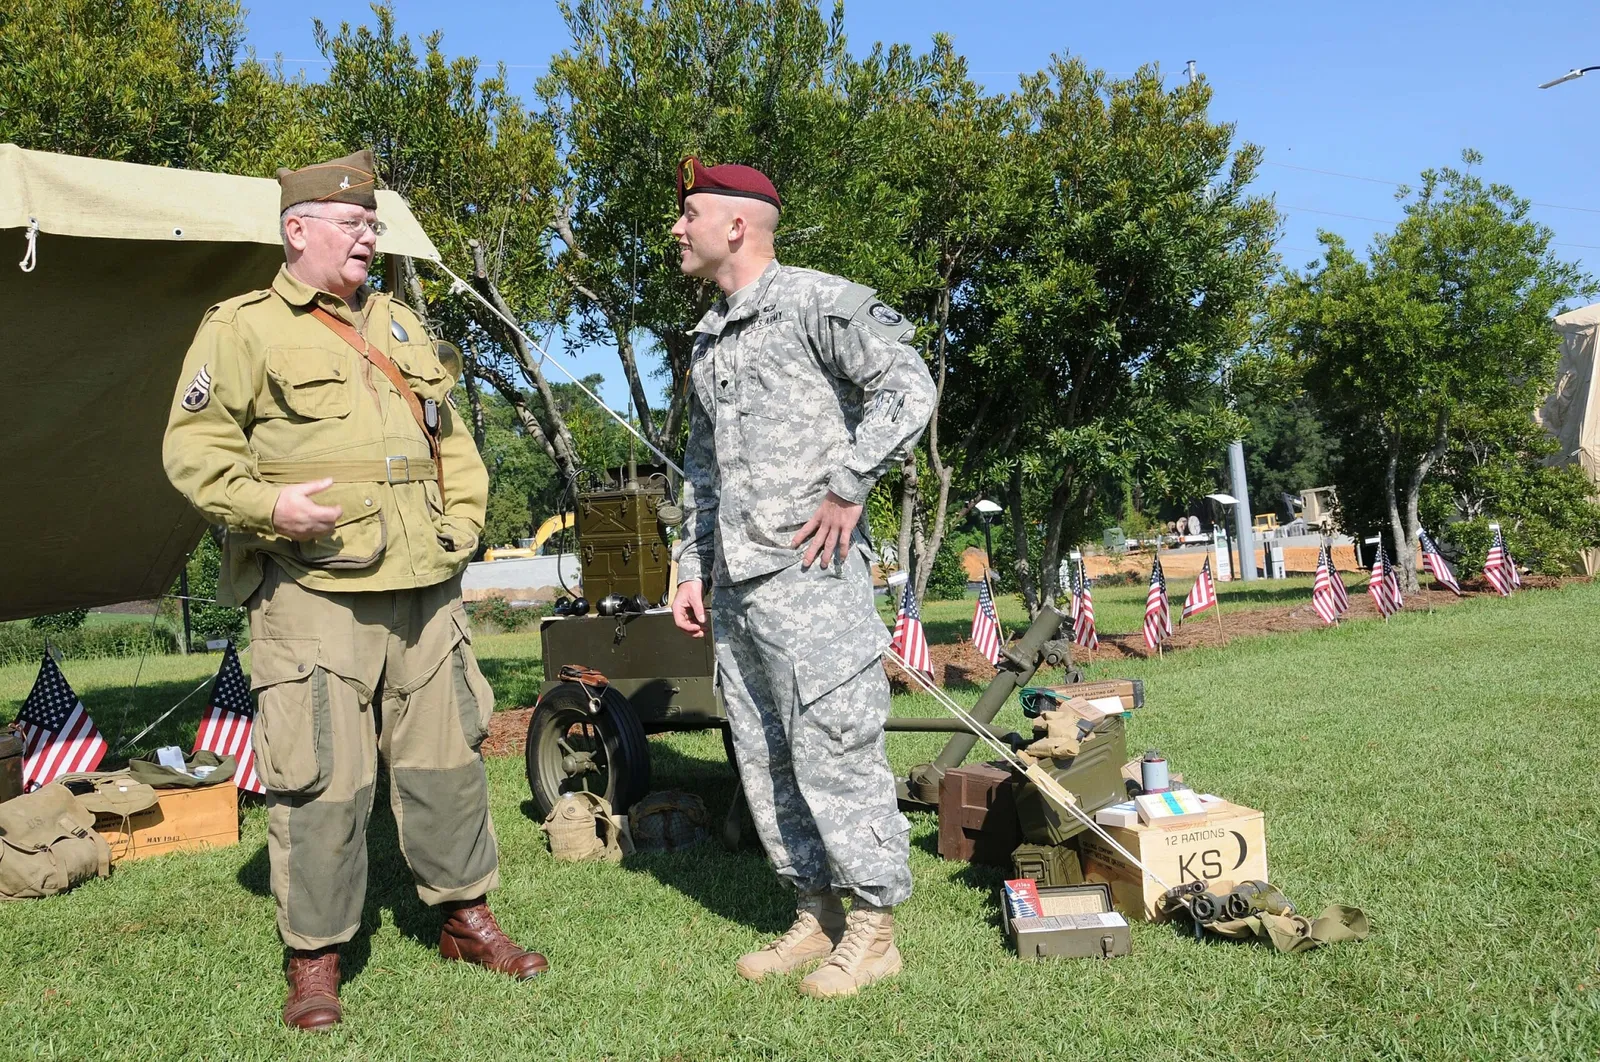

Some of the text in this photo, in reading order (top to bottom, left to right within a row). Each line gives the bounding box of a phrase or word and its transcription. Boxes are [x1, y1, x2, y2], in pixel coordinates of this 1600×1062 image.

[765, 310, 783, 324] ARMY
[1165, 828, 1225, 846] 12 RATIONS
[1179, 849, 1222, 883] KS
